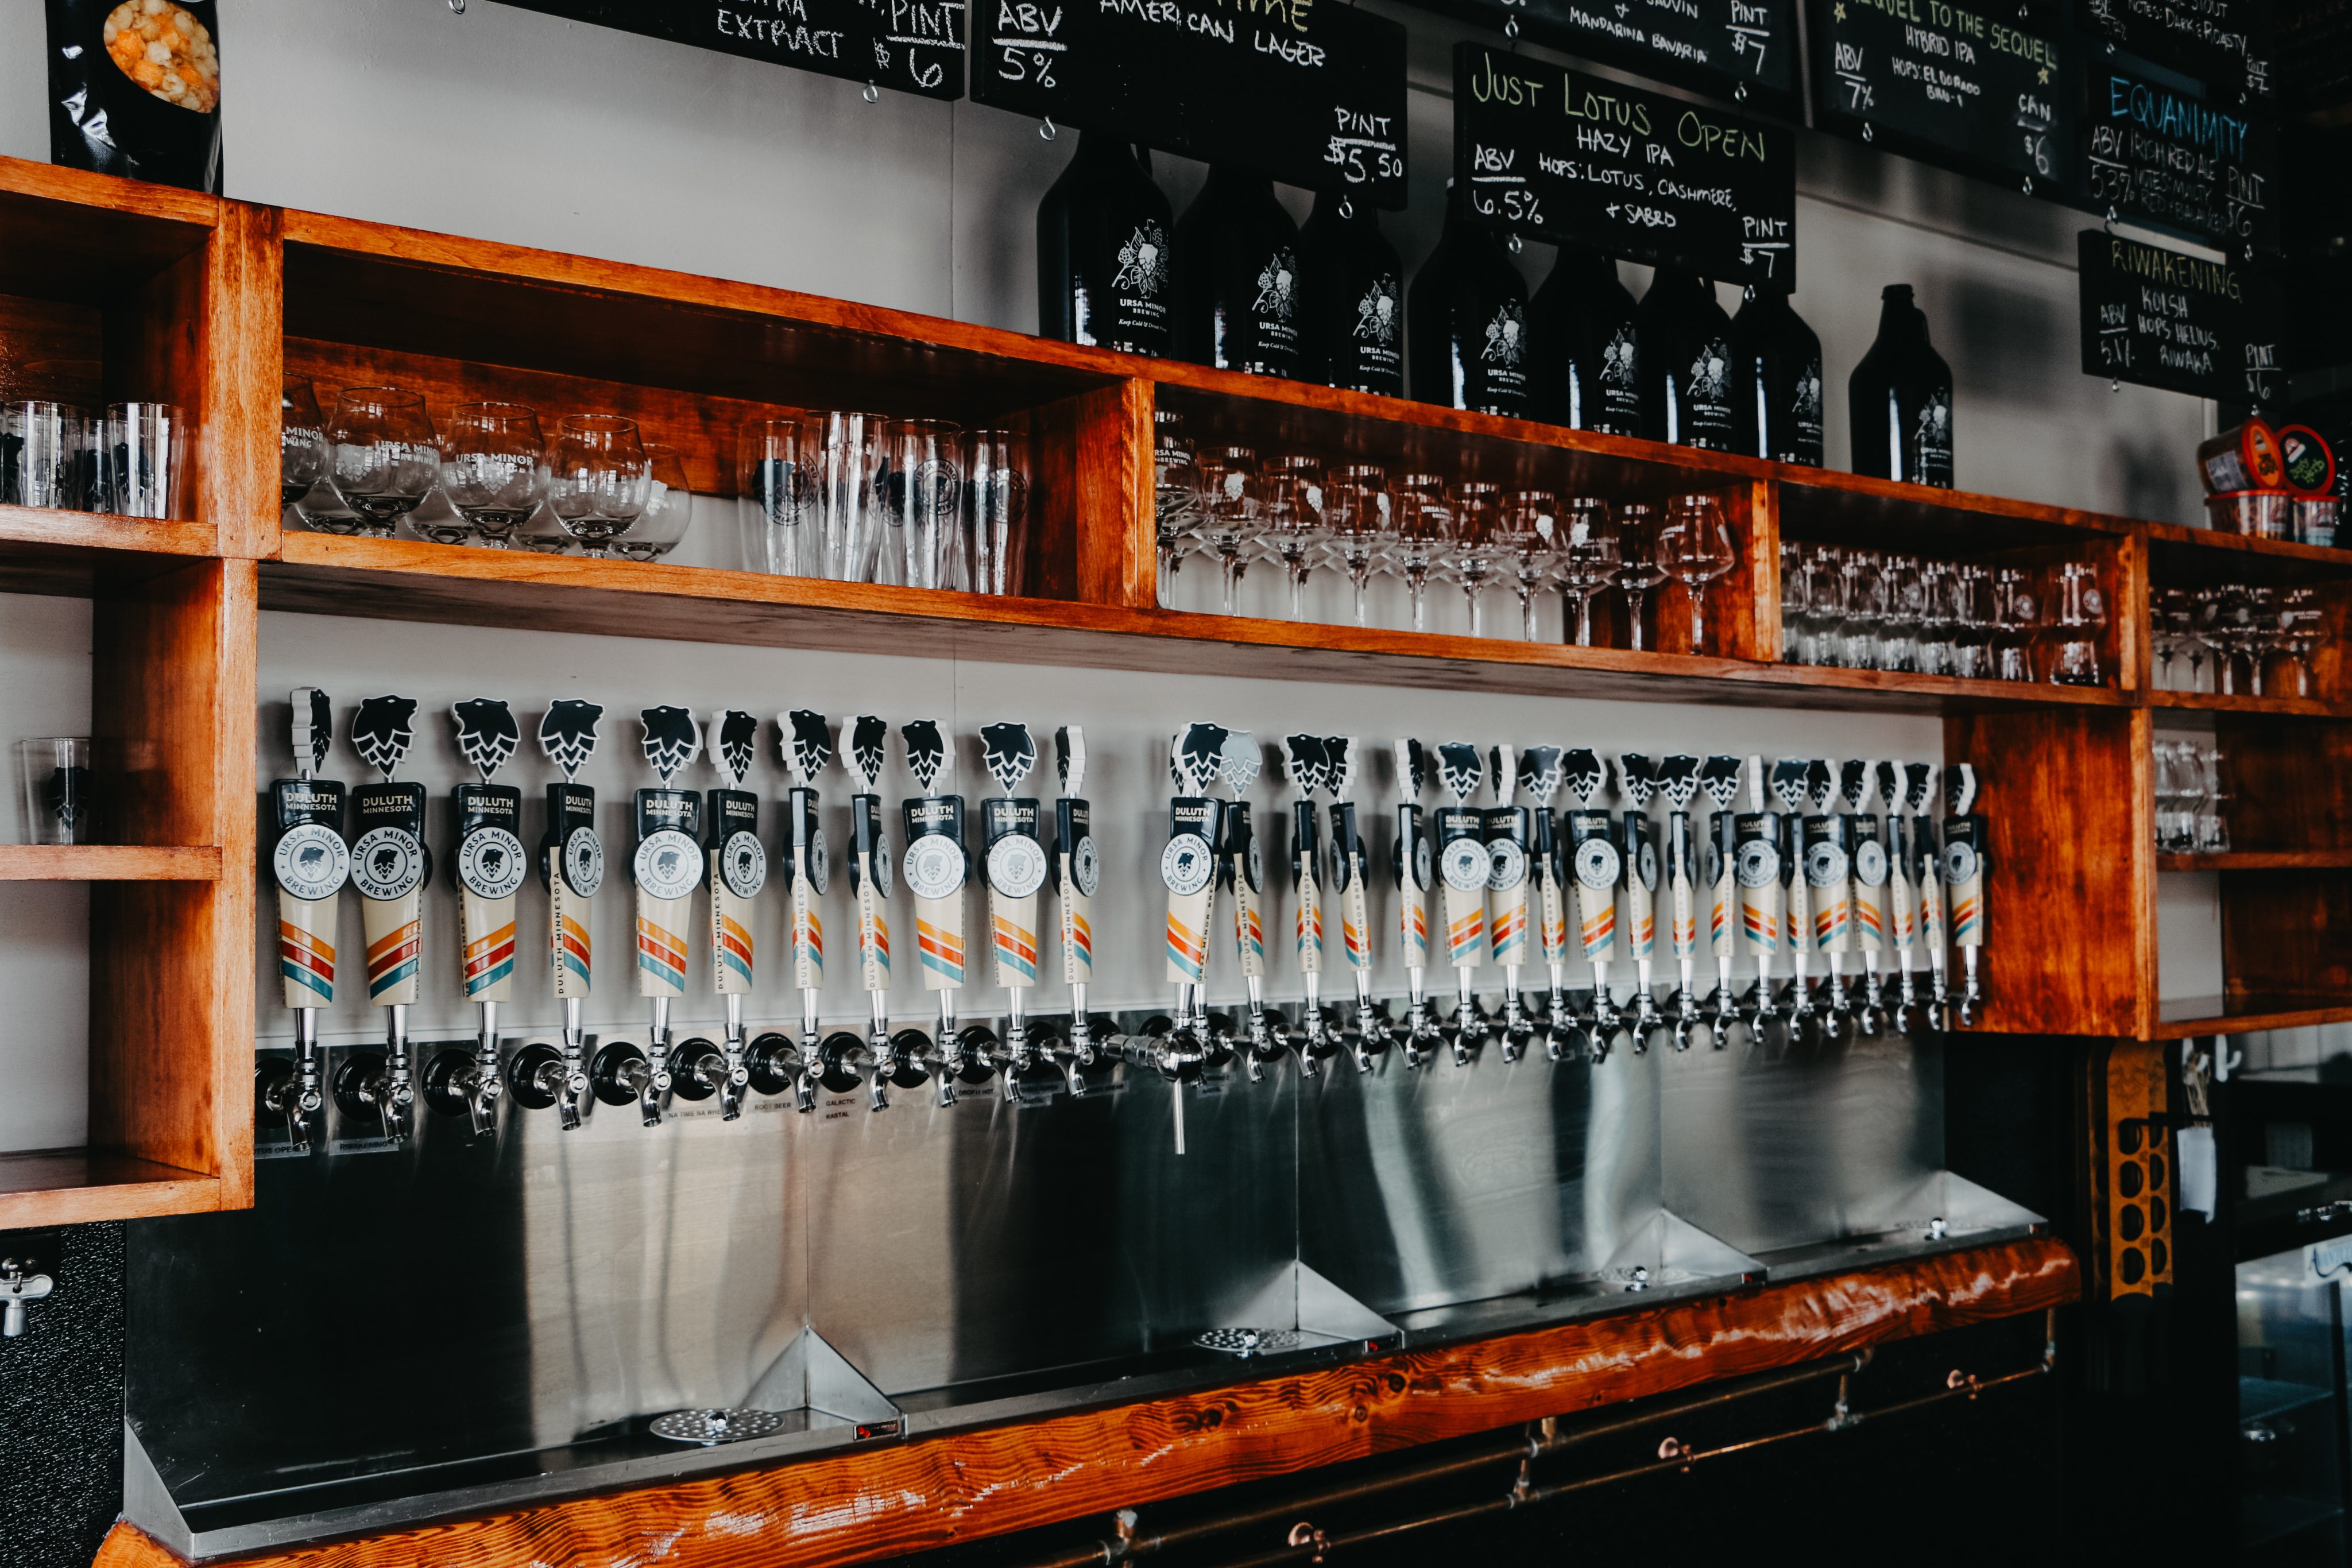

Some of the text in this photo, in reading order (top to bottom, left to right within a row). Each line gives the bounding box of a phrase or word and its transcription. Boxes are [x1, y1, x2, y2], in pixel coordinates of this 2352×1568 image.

[891, 0, 965, 44] PINT
[998, 5, 1062, 36] ABV
[1731, 0, 1767, 25] PINT
[718, 9, 844, 58] EXTRACT
[1100, 0, 1325, 65] AMERICAN LAGER
[1570, 7, 1707, 63] MANDARINA BAVARIA
[1930, 1, 2057, 70] TO THE SEQUEL
[1732, 33, 1765, 74] $7
[1836, 42, 1863, 71] ABV
[1906, 25, 1975, 65] HYBRID IPA
[999, 48, 1055, 88] 5%
[1924, 65, 1936, 83] EL
[1940, 69, 1980, 95] DORADO
[1846, 81, 1874, 110] 7%
[1473, 53, 1765, 162] JUST LOTUS OPEN
[2018, 94, 2050, 121] CAN
[1336, 106, 1390, 136] PINT
[2111, 76, 2247, 163] EQUANIMITY
[1577, 125, 1674, 167] HAZY IPA
[2092, 126, 2122, 159] ABV
[1324, 136, 1402, 183] $5.50
[1475, 144, 1514, 172] ABV
[2024, 134, 2048, 175] $6
[2131, 128, 2215, 181] IRISH RED ALE
[2229, 166, 2264, 202] PINT
[1473, 190, 1544, 224] 6.5%
[1743, 216, 1788, 238] PINT
[1740, 248, 1774, 278] $7
[2112, 241, 2242, 303] RIWAKENING
[1120, 299, 1166, 314] URSA MINOR
[1133, 308, 1159, 318] BREWING
[2142, 285, 2187, 318] KOLSH
[2101, 304, 2125, 324] ABV
[1259, 322, 1279, 331] URSA
[1271, 331, 1293, 341] BREWING
[1360, 346, 1380, 354] URSA
[1372, 355, 1394, 363] BREWING
[2160, 345, 2212, 374] RIWAKA
[2245, 344, 2275, 366] PINT
[285, 427, 324, 442] MINOR
[375, 440, 409, 452] URSA
[456, 453, 533, 466] URSA MINOR
[286, 793, 336, 803] DULUTH
[286, 803, 336, 811] MINNESOTA
[363, 795, 412, 807] DULUTH
[467, 796, 513, 807] DULUTH
[566, 795, 591, 807] DULUTH
[646, 799, 693, 811] DULUTH
[726, 800, 755, 812] DULUTH
[363, 806, 412, 814] MINNESOTA
[467, 807, 513, 815] MINNESOTA
[566, 806, 591, 814] MINNESOTA
[646, 809, 692, 818] MINNESOTA
[726, 810, 754, 819] MINNESOTA
[911, 805, 954, 817] DULUTH
[912, 815, 954, 823] MINNESOTA
[994, 807, 1034, 817] DULUTH
[1175, 807, 1210, 816] DULUTH
[1445, 815, 1479, 824] DULUTH
[279, 828, 345, 858] URSA MINOR
[354, 830, 417, 861] URSA MINOR
[463, 831, 521, 858] URSA MINOR
[568, 830, 601, 858] URSA MINOR
[639, 834, 698, 861] URSA MINOR
[726, 834, 763, 862] URSA MINOR
[907, 839, 960, 865] URSA MINOR
[991, 838, 1042, 863] URSA MINOR
[1165, 837, 1208, 862] URSA MINOR
[1464, 842, 1486, 861] MINOR
[285, 876, 340, 895] BREWING
[360, 876, 413, 896] BREWING
[469, 876, 517, 895] BREWING
[571, 874, 599, 893] BREWING
[644, 877, 694, 896] BREWING
[730, 876, 761, 894] BREWING
[912, 877, 957, 895] BREWING
[996, 878, 1039, 894] BREWING
[1167, 876, 1202, 891] BREWING
[1449, 875, 1484, 888] BREWING
[554, 873, 562, 940] MINNESOTA
[864, 877, 872, 939] MINNESOTA
[1238, 874, 1248, 929] MINNESOTA
[826, 1098, 856, 1107] GALACTIC
